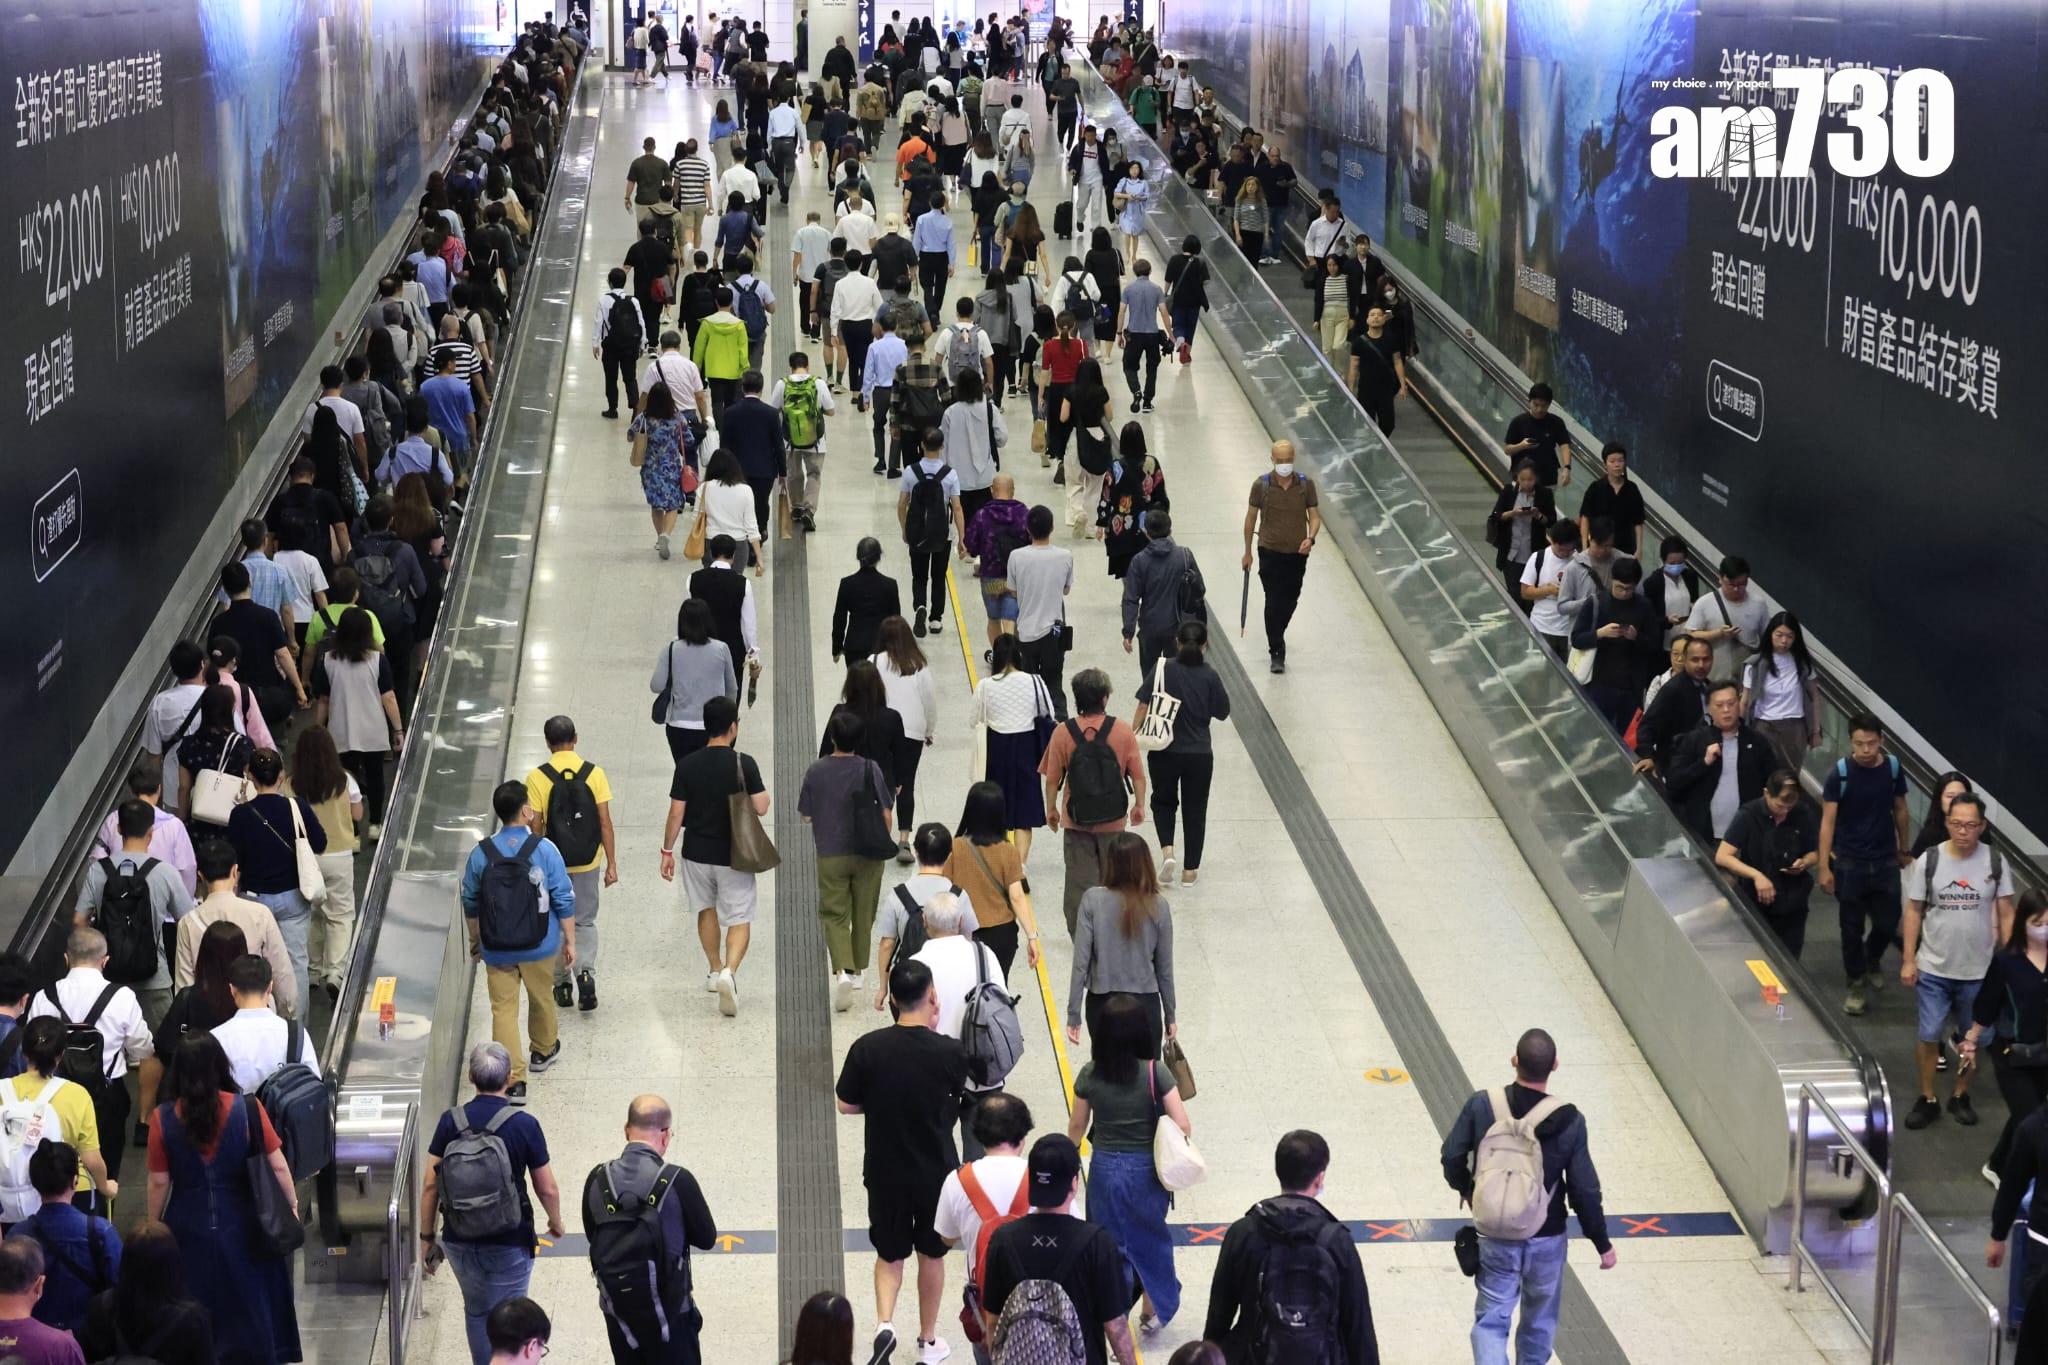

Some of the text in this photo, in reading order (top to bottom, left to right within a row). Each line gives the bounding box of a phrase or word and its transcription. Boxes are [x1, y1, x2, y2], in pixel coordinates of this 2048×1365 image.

[15, 48, 163, 147] 全新客戶開立優先理財可享高達
[19, 184, 104, 312] HK$22,000
[120, 151, 181, 260] HK$10,000
[1848, 176, 1982, 306] HK$10,000
[1711, 251, 1766, 320] 現金回贈
[24, 327, 75, 426] 現金回贈
[1841, 295, 2001, 420] 財富產品結存獎賞
[1938, 893, 1981, 901] WINNERS
